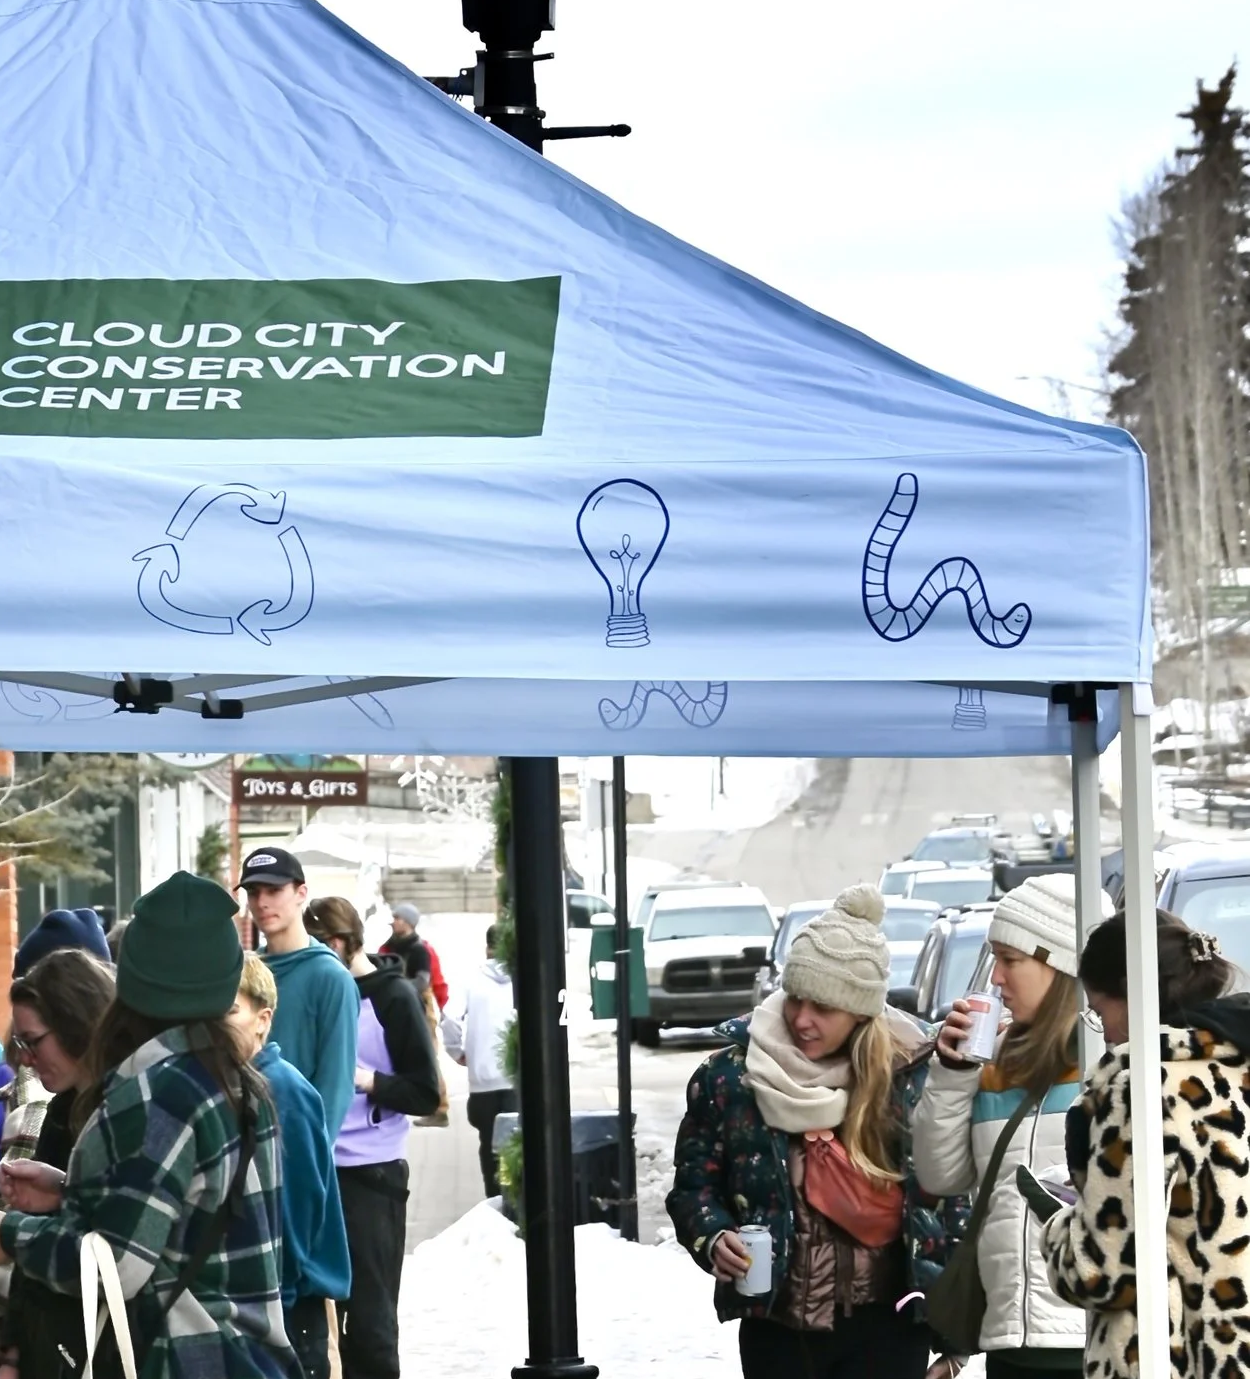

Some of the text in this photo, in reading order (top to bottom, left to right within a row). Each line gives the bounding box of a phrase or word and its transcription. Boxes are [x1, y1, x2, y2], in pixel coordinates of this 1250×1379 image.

[12, 321, 406, 349] CLOUD CITY
[1, 350, 506, 380] CONSERVATION
[290, 781, 303, 796] &
